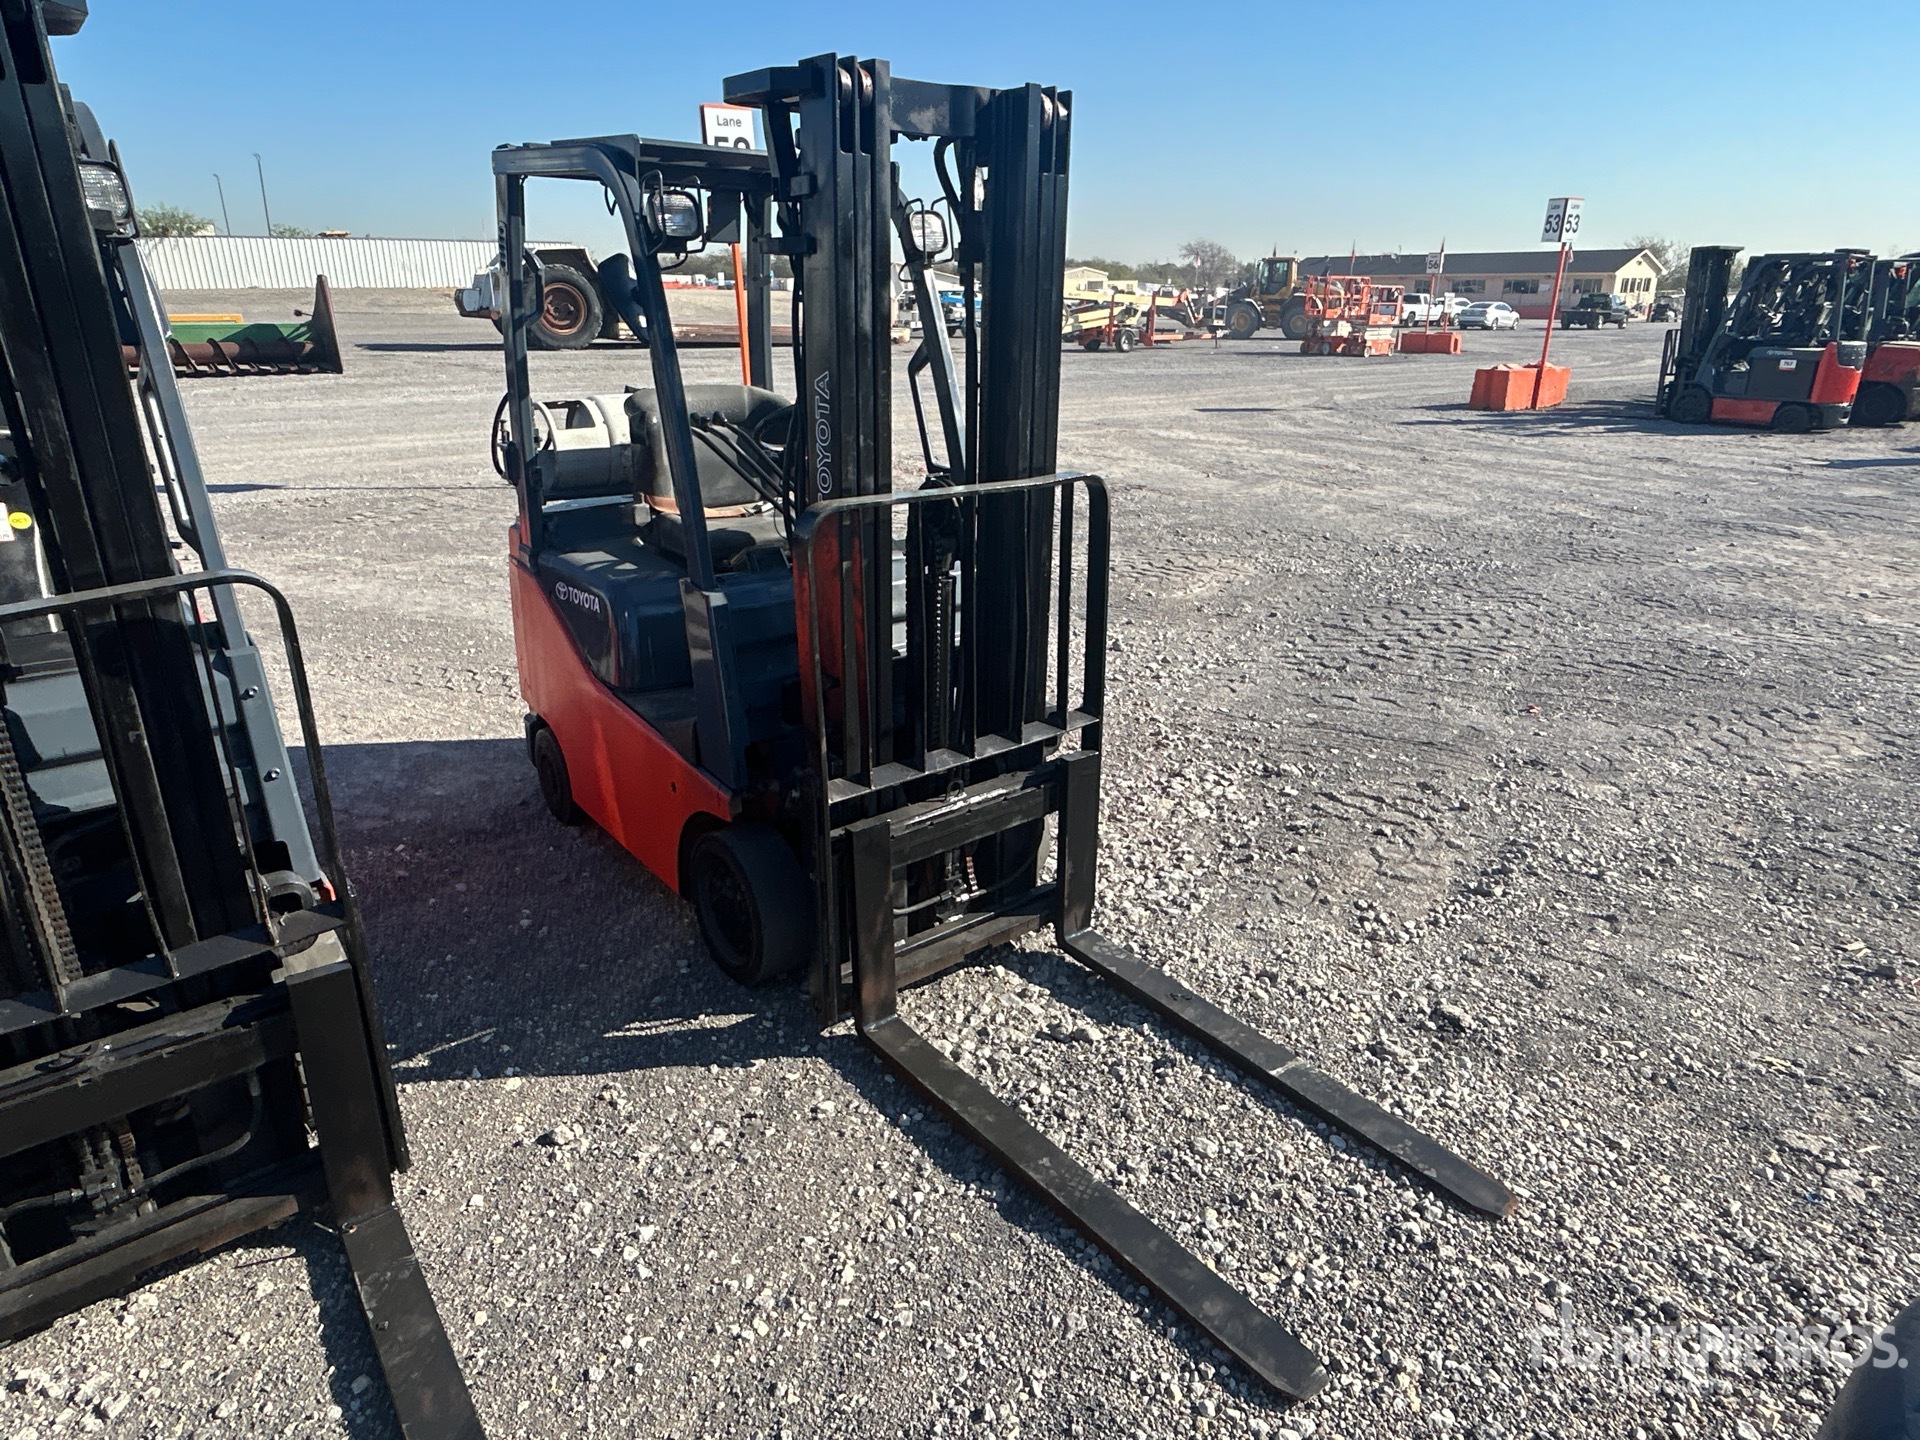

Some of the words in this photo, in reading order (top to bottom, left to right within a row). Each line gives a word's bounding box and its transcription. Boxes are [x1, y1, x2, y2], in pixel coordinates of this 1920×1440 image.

[716, 115, 742, 127] Lane
[1544, 214, 1561, 233] 53
[1565, 214, 1580, 233] 53
[1428, 260, 1438, 269] 56
[814, 370, 833, 502] OYOTA
[568, 586, 600, 614] TOYOTA
